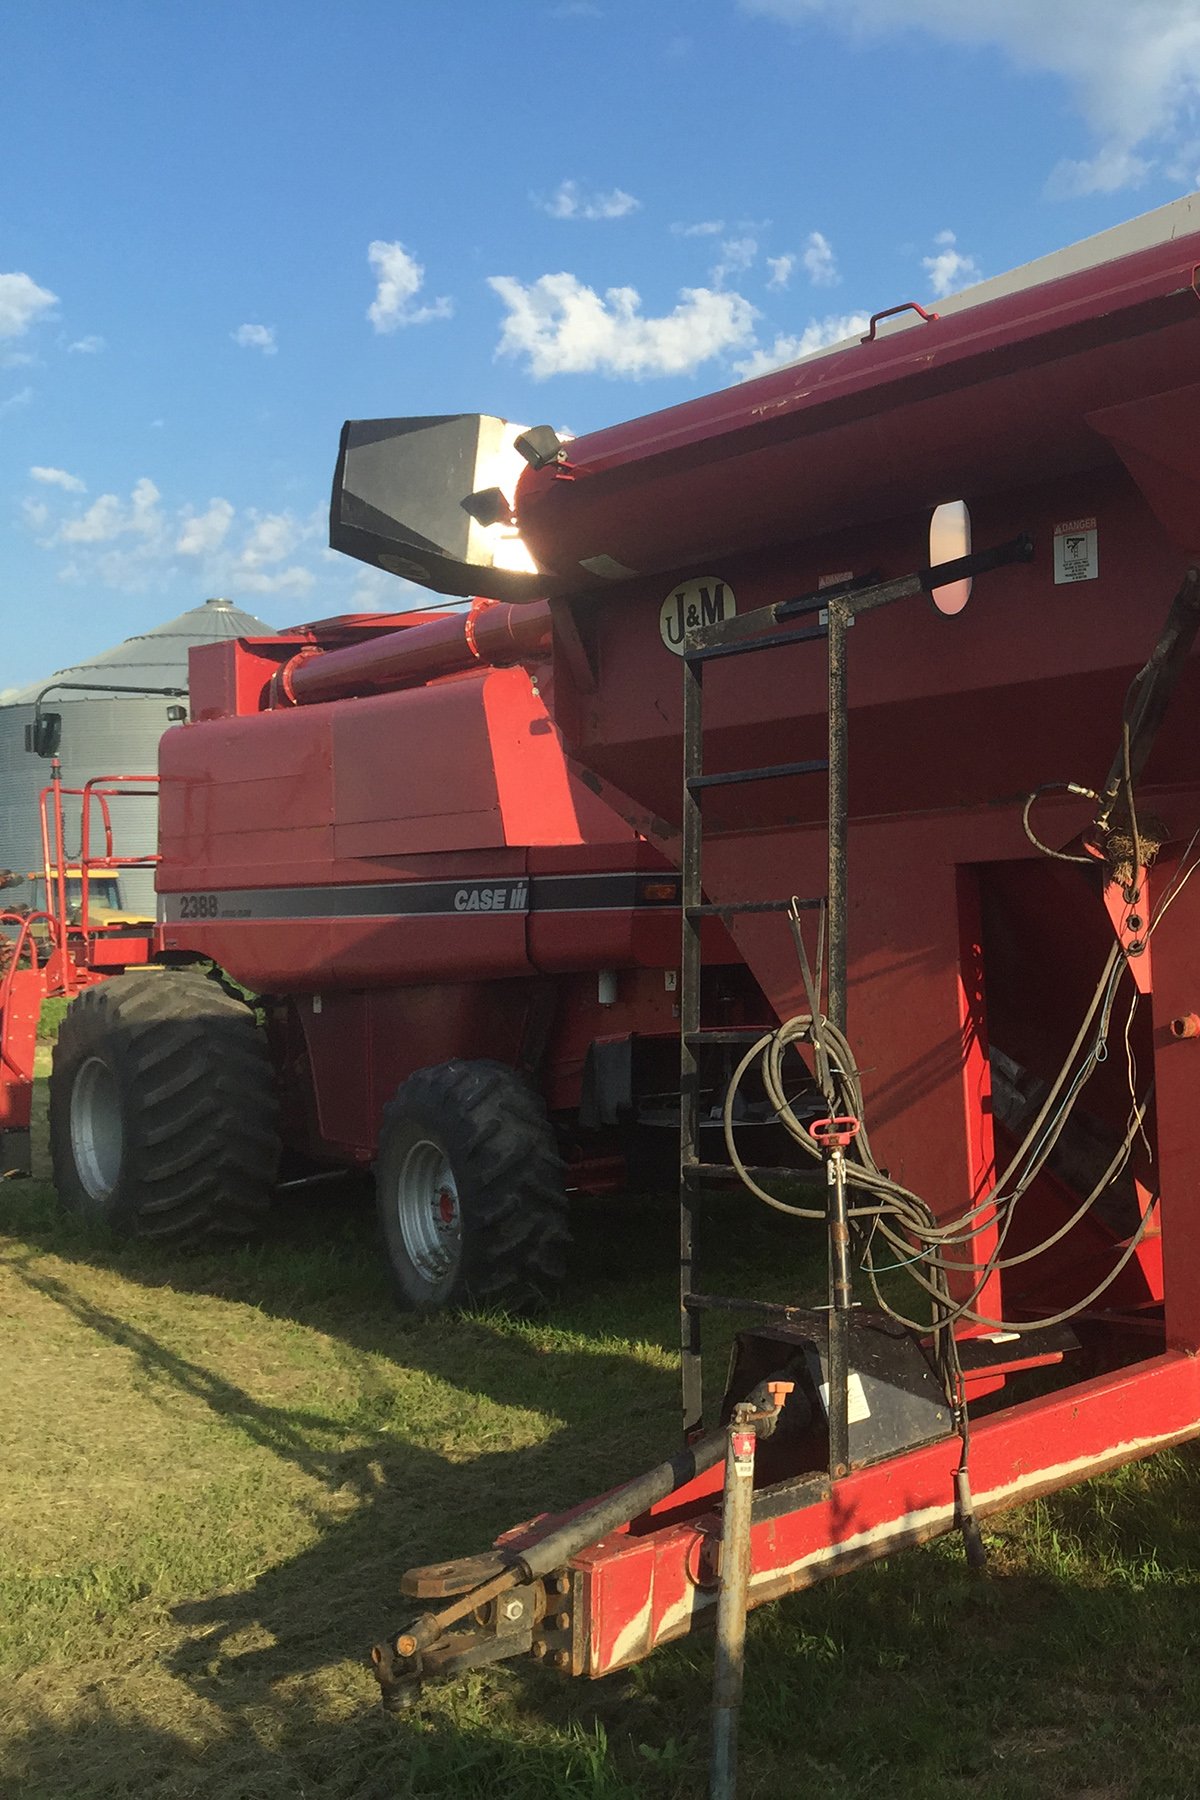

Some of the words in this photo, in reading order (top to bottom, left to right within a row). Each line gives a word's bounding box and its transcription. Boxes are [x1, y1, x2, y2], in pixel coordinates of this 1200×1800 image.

[1062, 518, 1097, 532] DANGER
[665, 583, 725, 644] J&M
[180, 894, 218, 919] 2388
[454, 889, 507, 911] CASE
